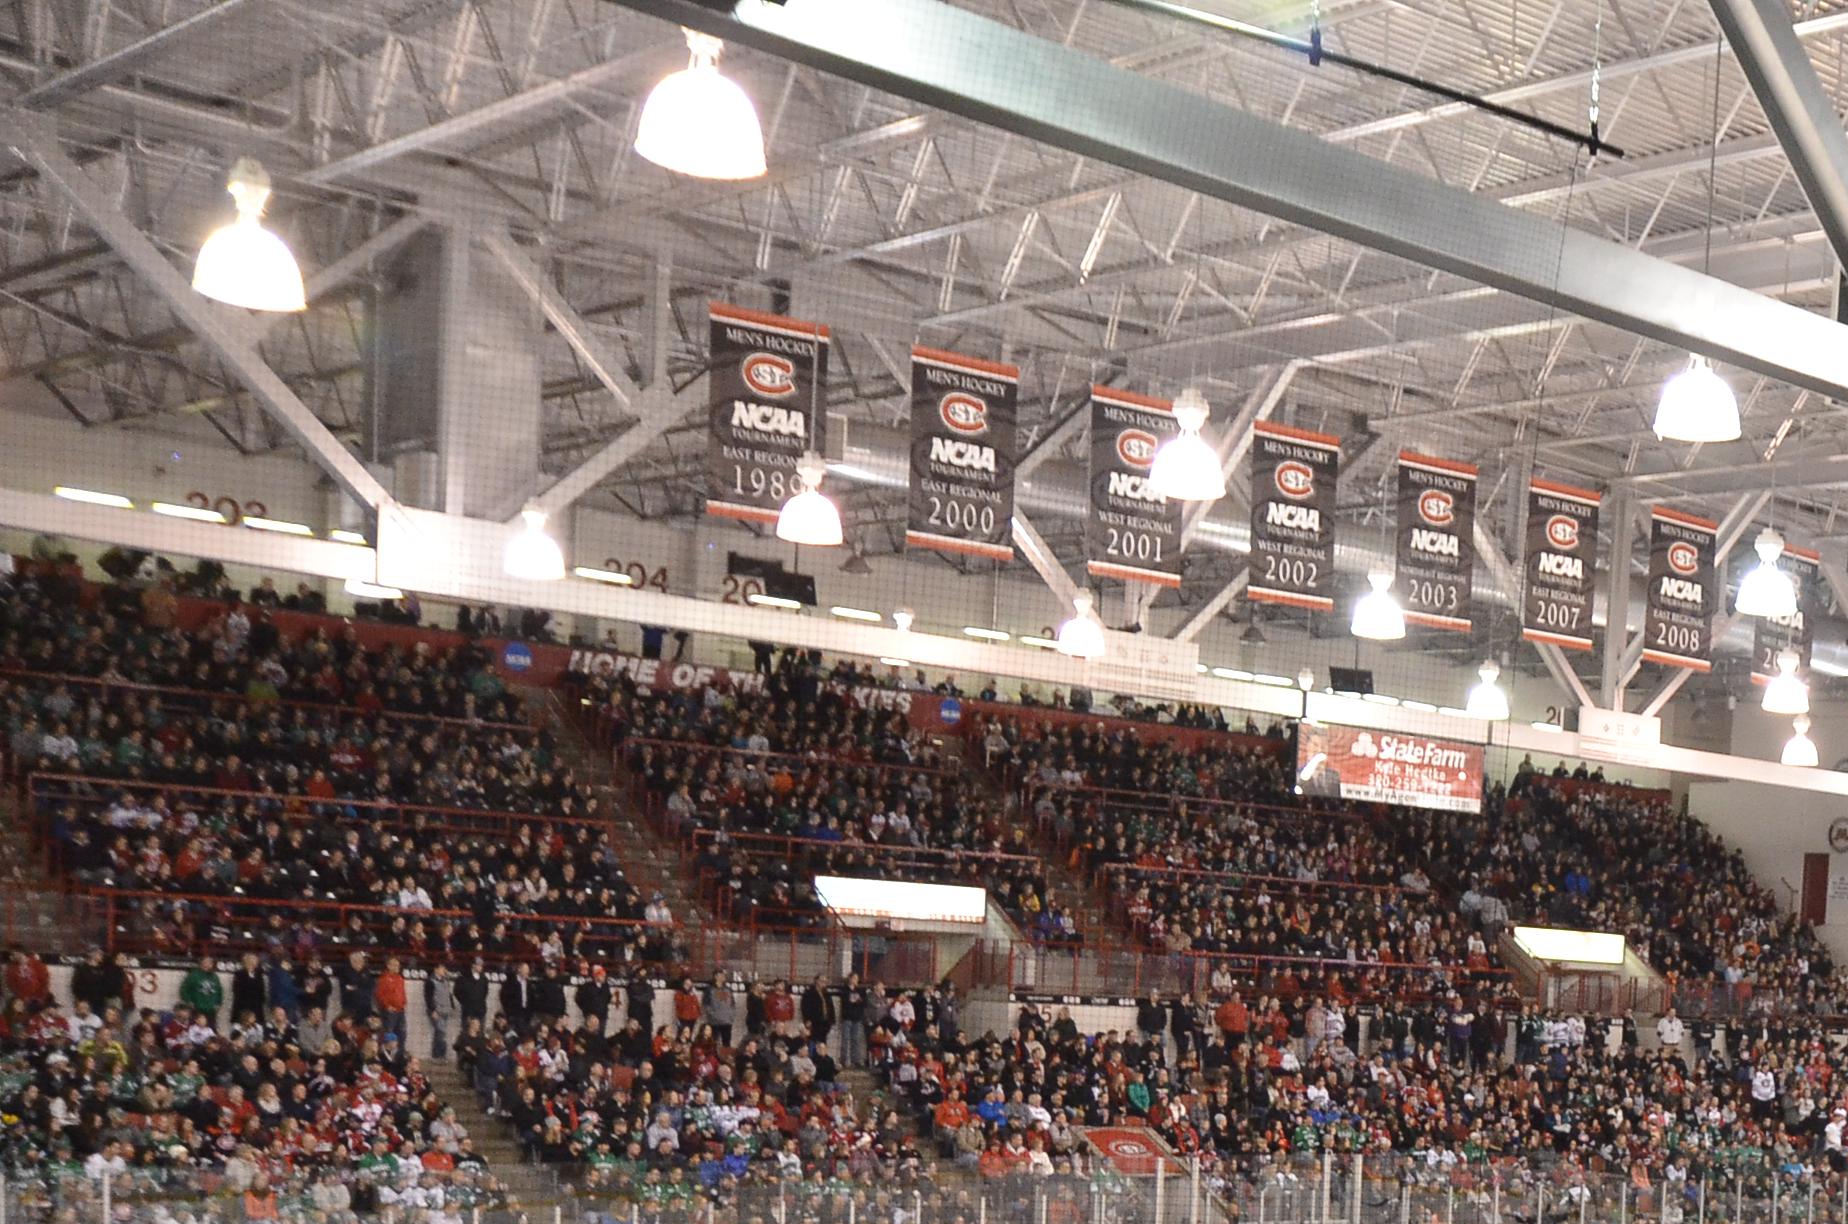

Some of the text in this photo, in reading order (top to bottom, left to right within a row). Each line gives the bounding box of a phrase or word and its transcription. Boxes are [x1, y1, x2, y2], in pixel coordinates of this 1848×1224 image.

[726, 327, 815, 356] MEN'S HOCKEY
[926, 369, 1006, 397] MEN'S HOCKEY
[731, 400, 805, 437] NCAA
[1104, 407, 1135, 425] MEN'S
[732, 427, 806, 449] TOURNAMENT
[1264, 441, 1292, 457] MEN'S
[723, 445, 751, 461] EAST
[930, 437, 996, 472] NCAA
[930, 463, 996, 482] TOURNAMENT
[921, 478, 1001, 503] EAST REGIONAL
[928, 497, 994, 534] 2000
[1099, 510, 1173, 533] WEST REGIONAL
[1266, 501, 1320, 532] NCAA
[1107, 529, 1163, 563] 2001
[1411, 528, 1459, 556] NCAA
[1265, 555, 1317, 587] 2002
[1539, 552, 1583, 579] NCAA
[1409, 579, 1457, 609] 2003
[1660, 576, 1702, 603] NCAA
[1537, 600, 1580, 630] 2007
[1657, 623, 1699, 651] 2008
[672, 663, 715, 690] OF
[727, 668, 766, 695] TH
